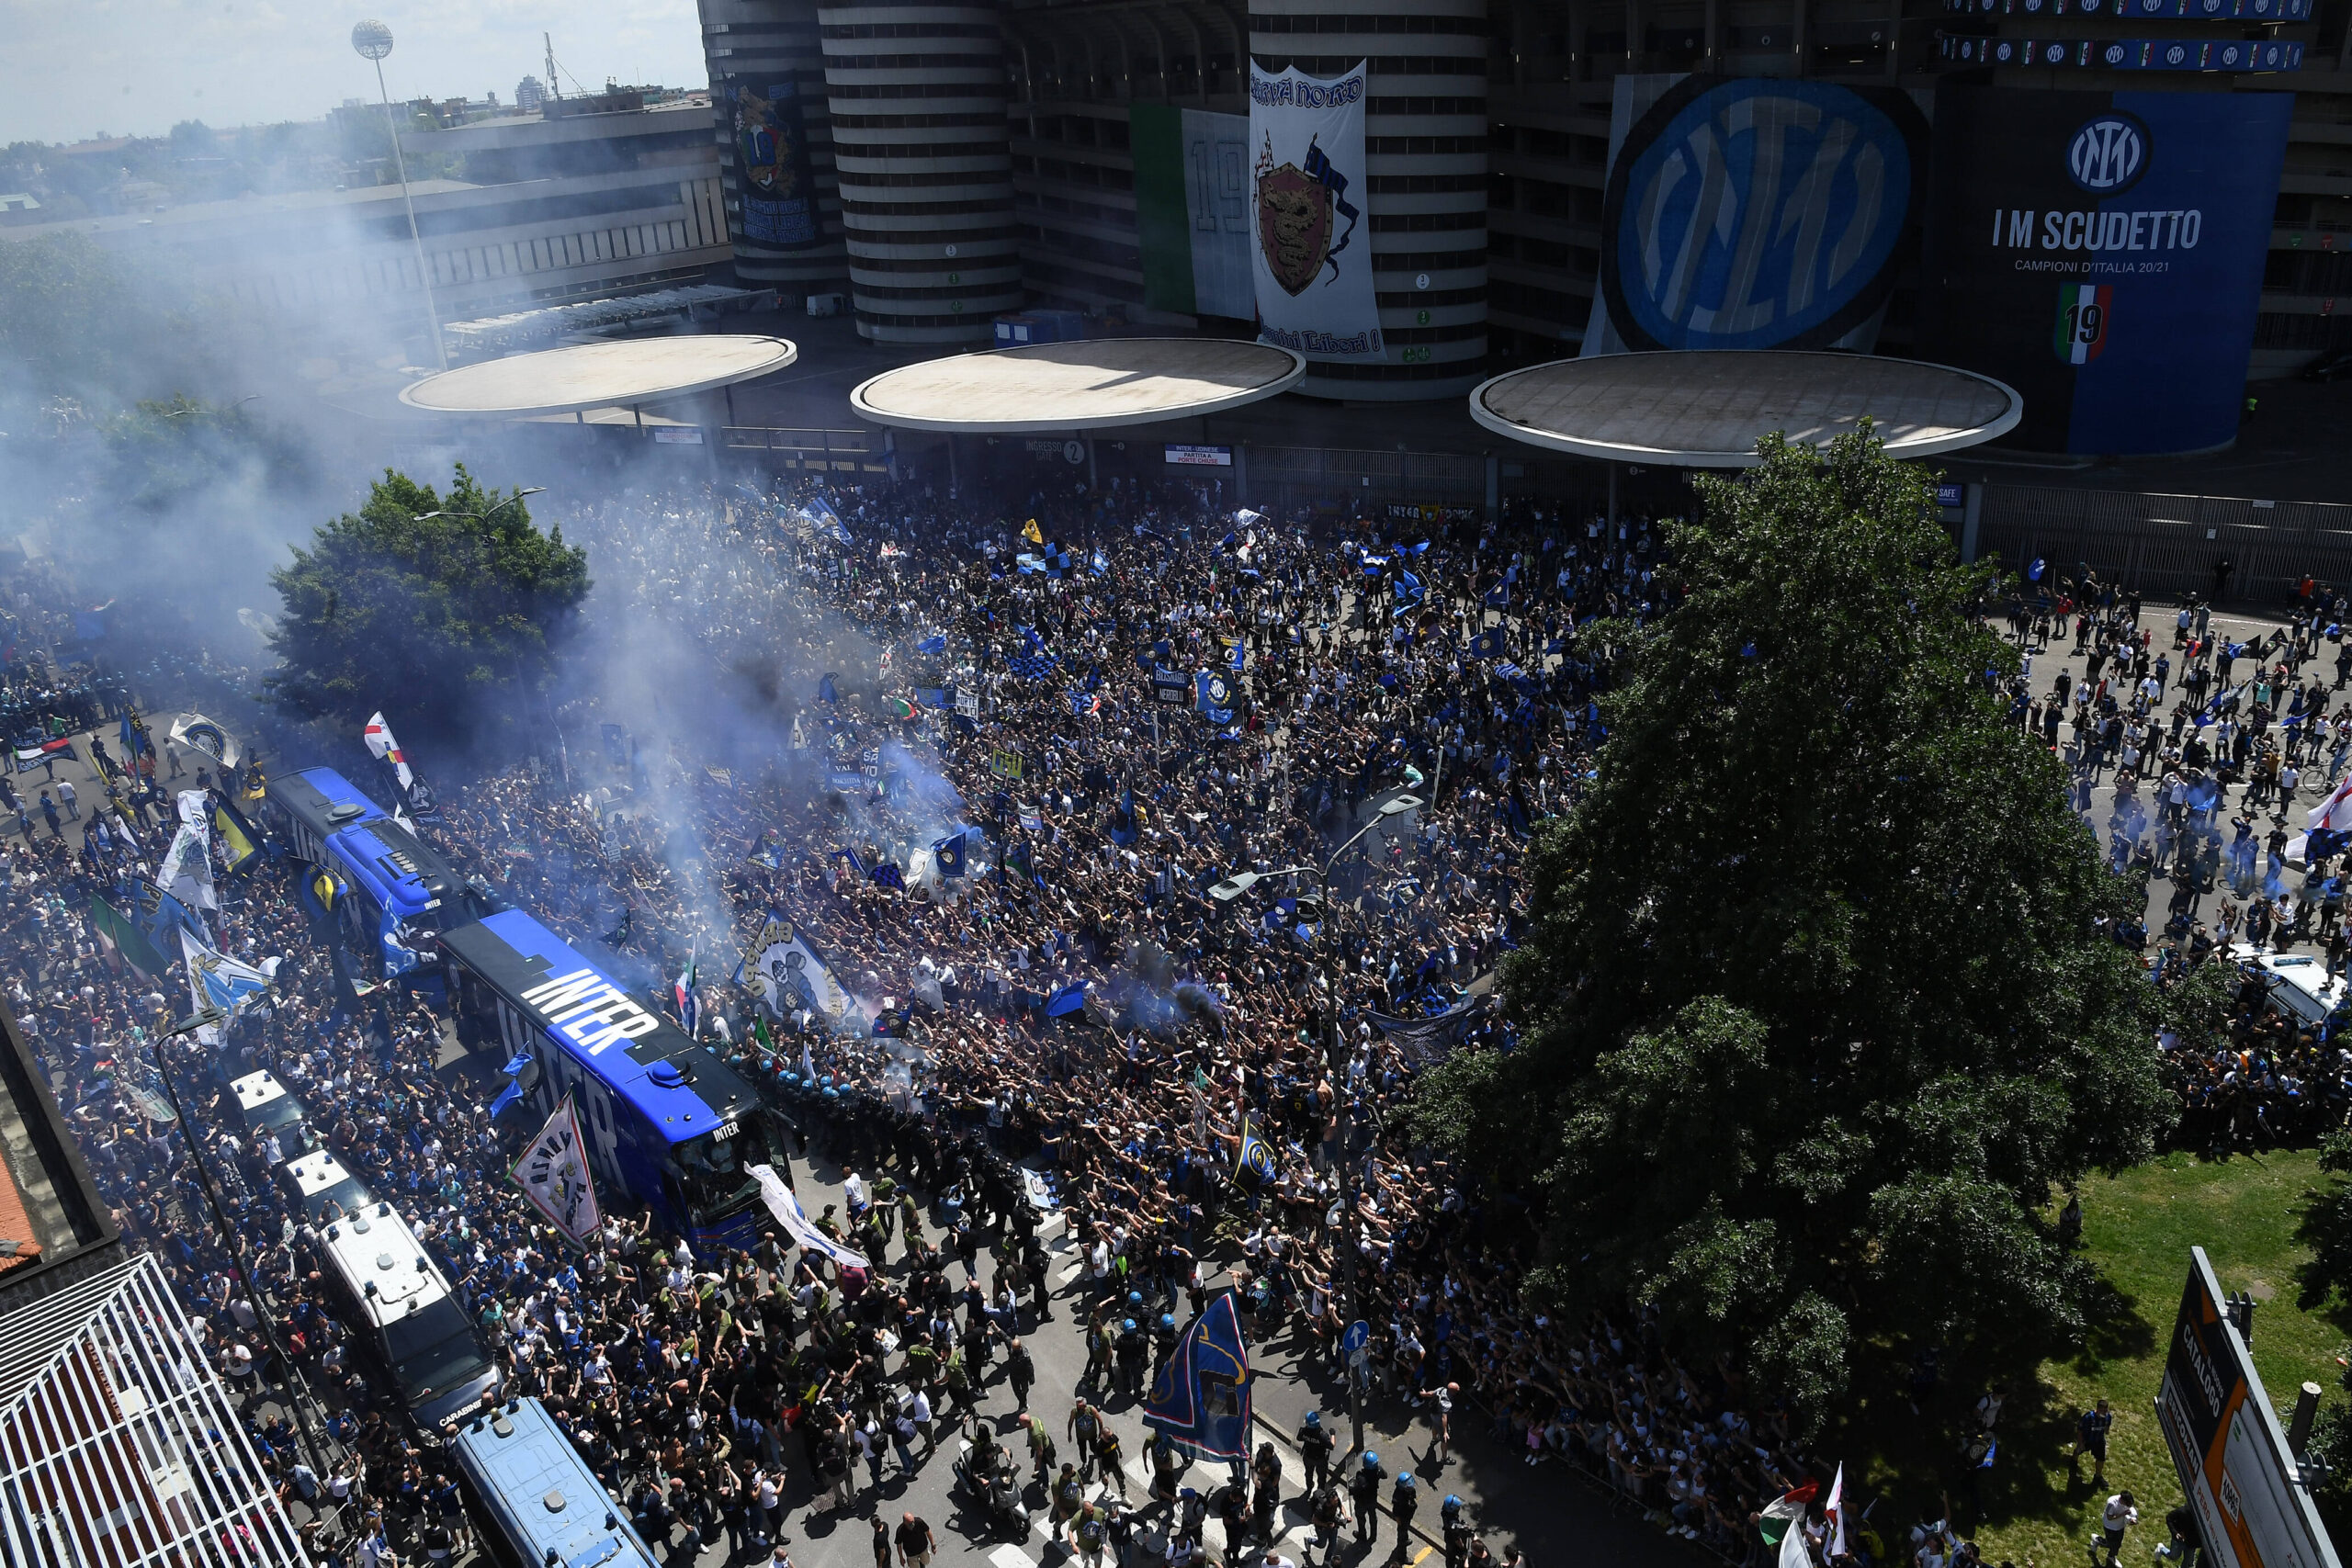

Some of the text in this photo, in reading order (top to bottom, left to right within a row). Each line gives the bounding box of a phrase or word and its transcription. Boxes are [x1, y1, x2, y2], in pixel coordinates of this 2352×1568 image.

[1295, 75, 1363, 108] NORD
[1992, 209, 2201, 250] I M SCUDETTO
[2015, 259, 2169, 273] CAMPIONI D'ITALIA 20/21
[2065, 303, 2103, 344] 19
[1302, 330, 1368, 353] Liberi
[1371, 329, 1381, 351] !
[1025, 440, 1061, 452] INGRESSO
[1069, 444, 1078, 460] 2
[1036, 451, 1052, 461] GATE
[1939, 488, 1956, 498] SAFE
[1388, 504, 1419, 518] INTER
[1159, 688, 1183, 702] NEROBLU
[864, 750, 878, 763] SA
[424, 898, 442, 909] INTER
[520, 967, 660, 1055] INTER
[712, 1121, 741, 1143] INTER
[2183, 1324, 2220, 1418] CATALOGO
[2167, 1391, 2199, 1474] BRICOMAN
